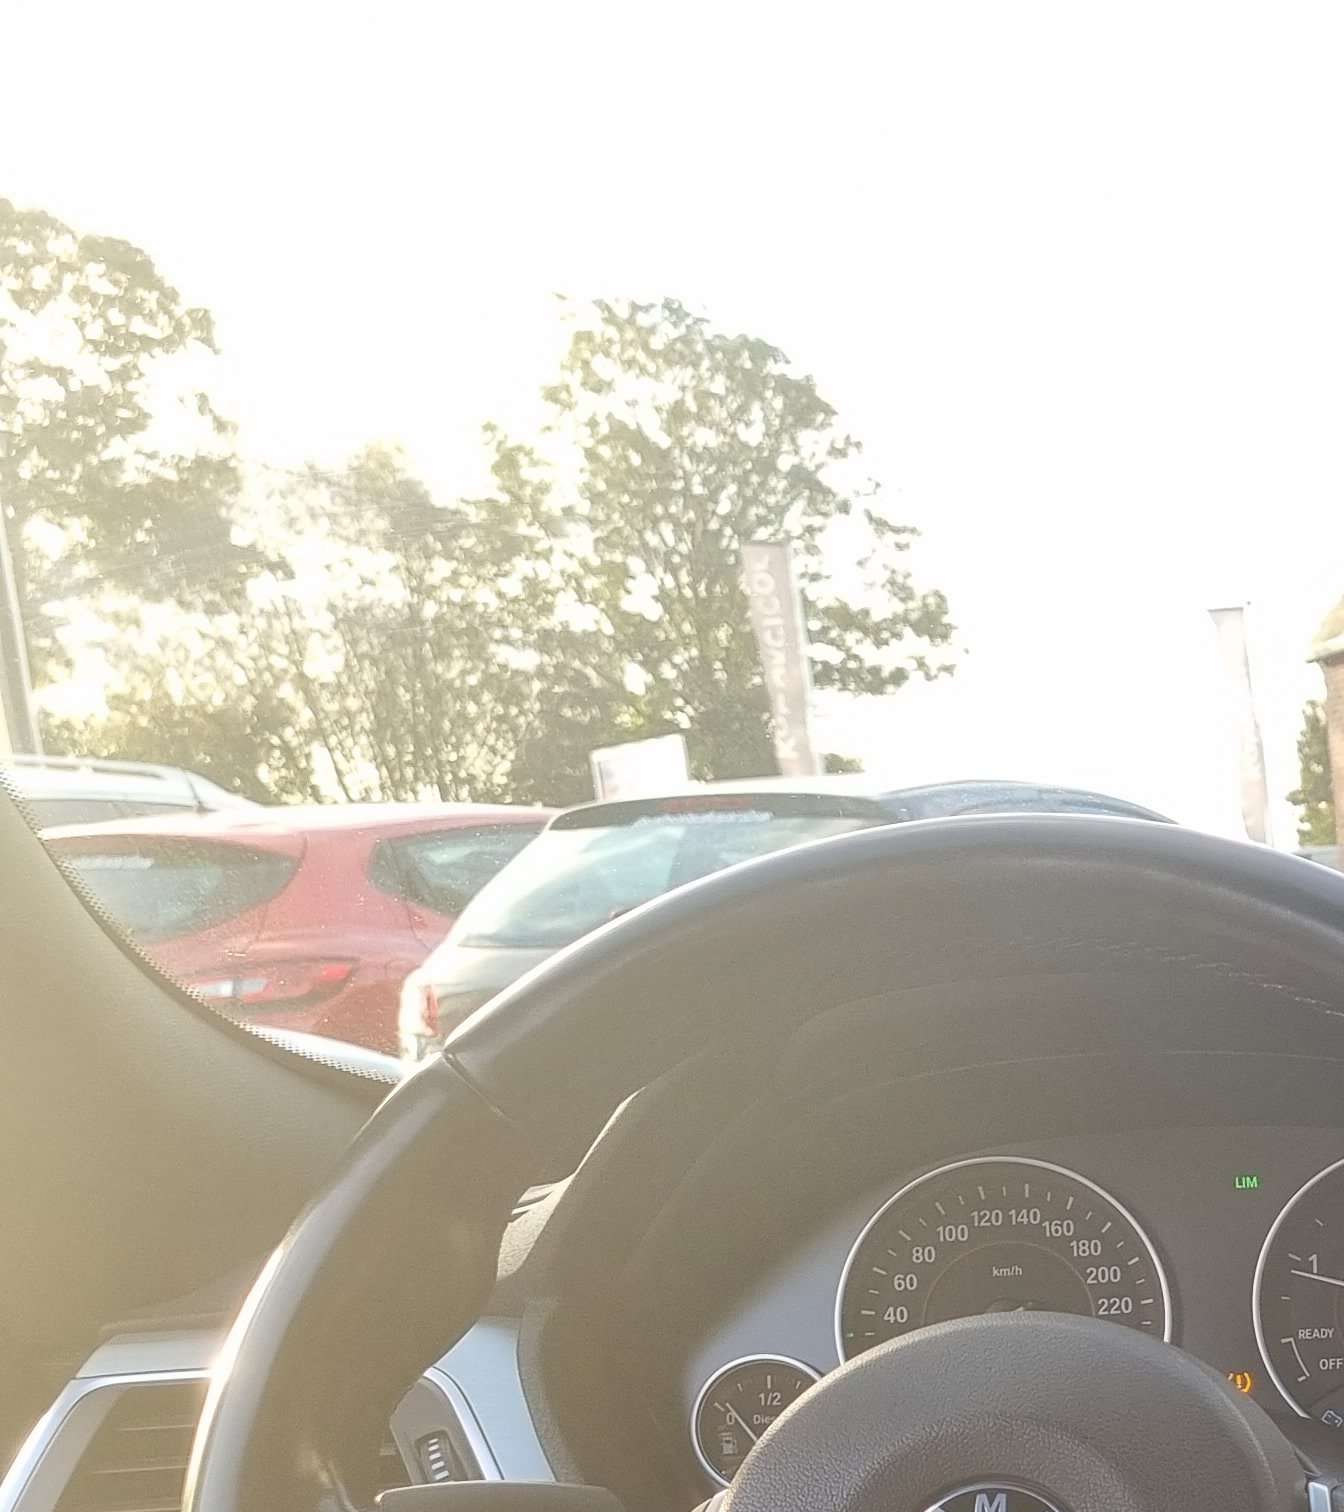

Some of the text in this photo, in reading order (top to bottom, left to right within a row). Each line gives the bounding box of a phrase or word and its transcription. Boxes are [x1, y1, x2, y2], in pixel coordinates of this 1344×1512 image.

[1235, 1177, 1258, 1189] LIM
[972, 1210, 1002, 1227] 120
[1009, 1209, 1040, 1225] 140
[936, 1225, 969, 1242] 100
[1042, 1220, 1074, 1237] 160
[912, 1246, 935, 1263] 80
[1070, 1240, 1101, 1257] 180
[993, 1264, 1022, 1278] km/h
[1308, 1254, 1318, 1273] 1
[894, 1274, 918, 1292] 60
[1086, 1267, 1121, 1284] 200
[1098, 1297, 1132, 1314] 220
[884, 1306, 908, 1324] 40
[1298, 1328, 1334, 1340] READY
[1319, 1358, 1343, 1370] OFF
[759, 1392, 781, 1406] 1/2
[726, 1412, 735, 1425] 0
